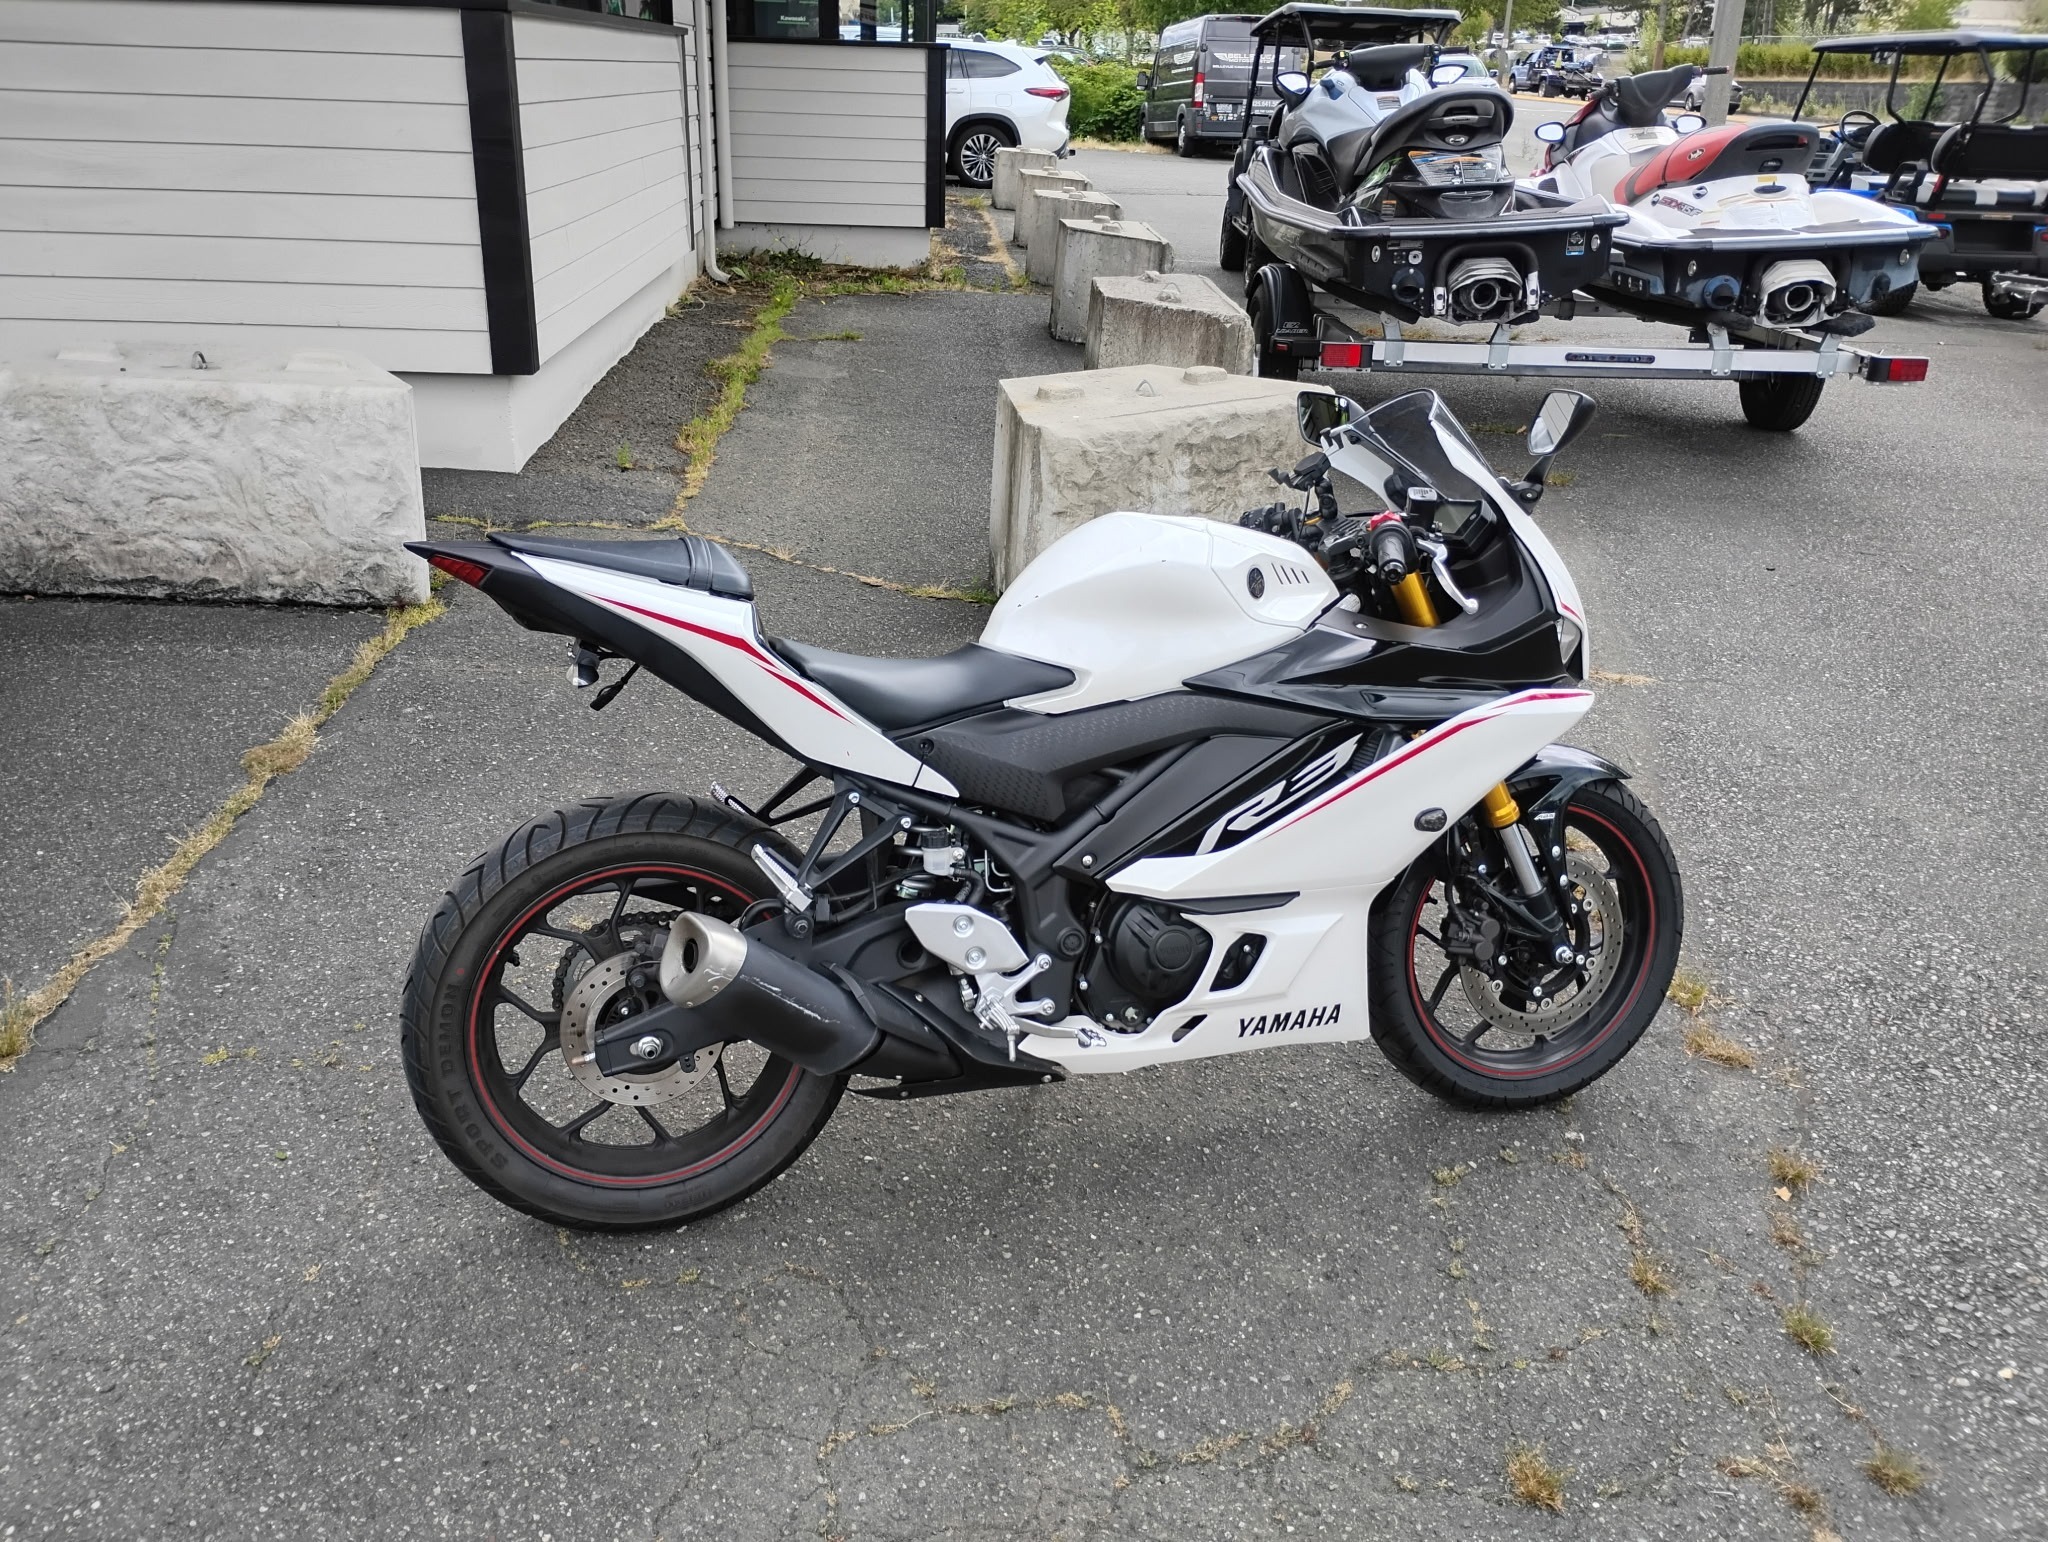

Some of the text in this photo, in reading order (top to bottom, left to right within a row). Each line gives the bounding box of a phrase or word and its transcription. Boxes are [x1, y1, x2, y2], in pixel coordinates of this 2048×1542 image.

[1195, 733, 1363, 856] R3
[439, 983, 509, 1170] SPORT DEMON
[1238, 1003, 1341, 1038] YAMAHA
